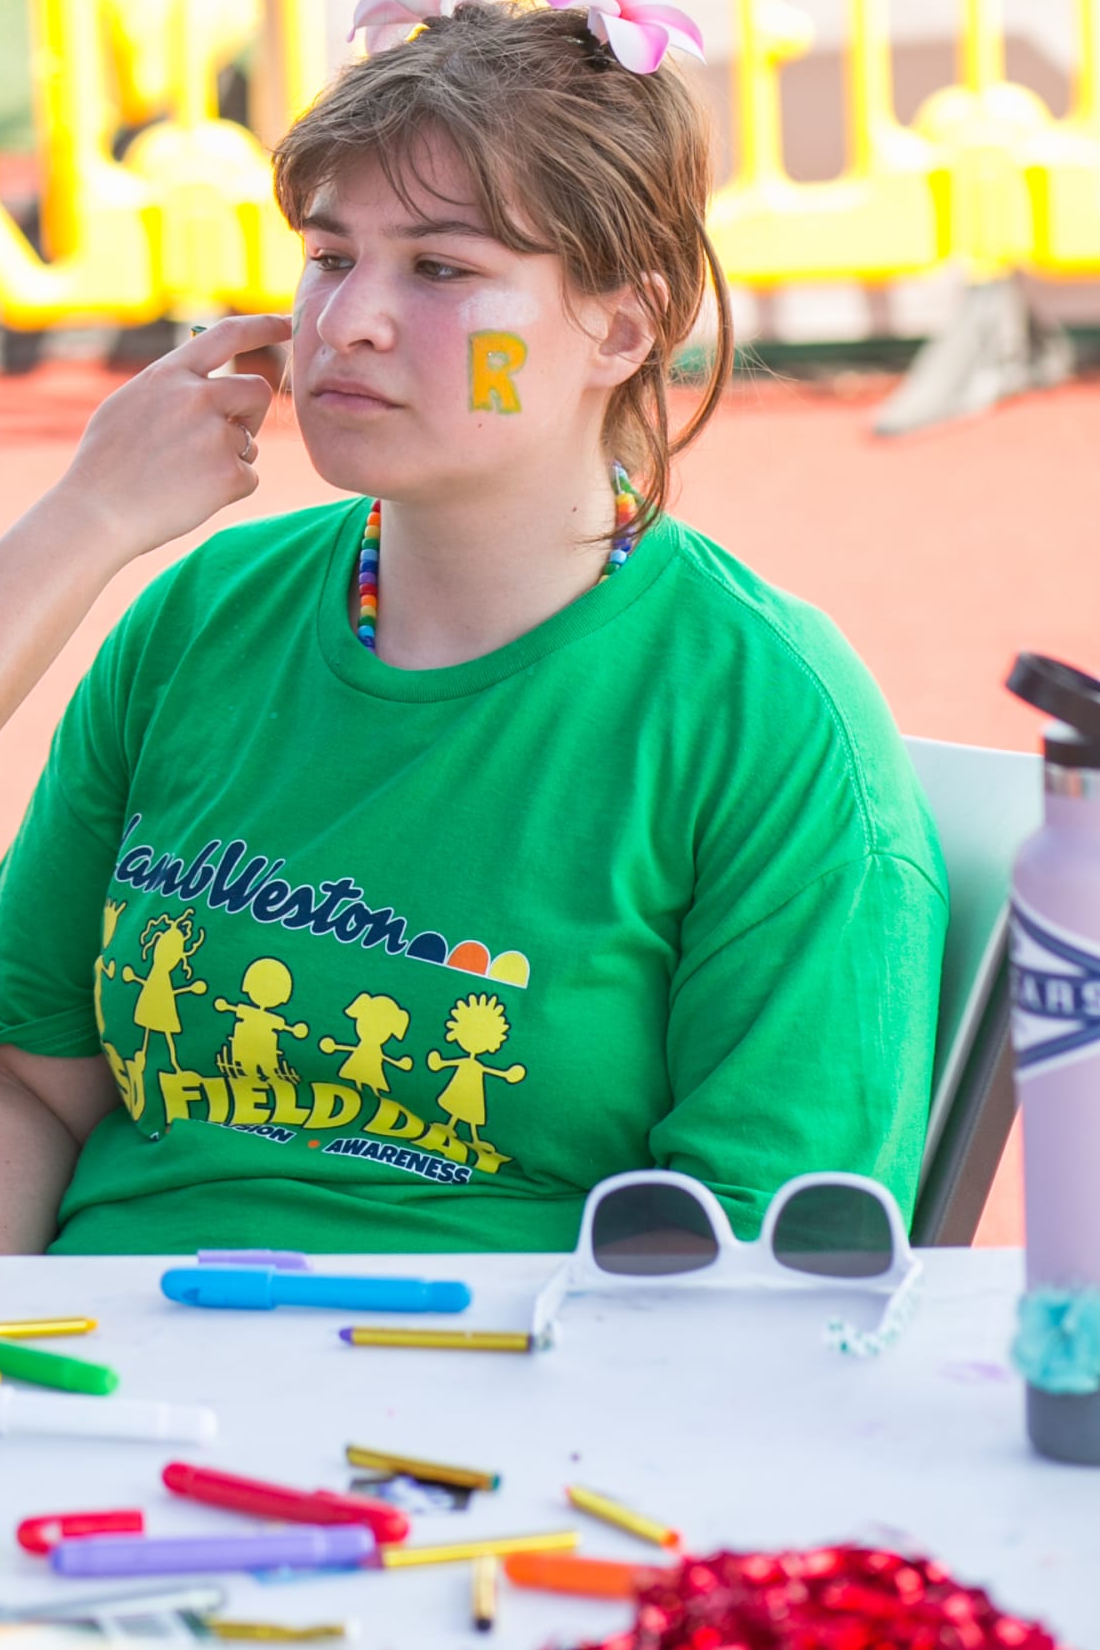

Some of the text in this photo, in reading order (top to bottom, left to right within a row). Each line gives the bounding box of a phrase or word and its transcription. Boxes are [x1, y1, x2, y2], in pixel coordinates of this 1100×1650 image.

[467, 329, 528, 414] R
[157, 1068, 362, 1130] FIELD
[362, 1096, 513, 1174] DAY
[321, 1137, 473, 1185] AWARENESS
